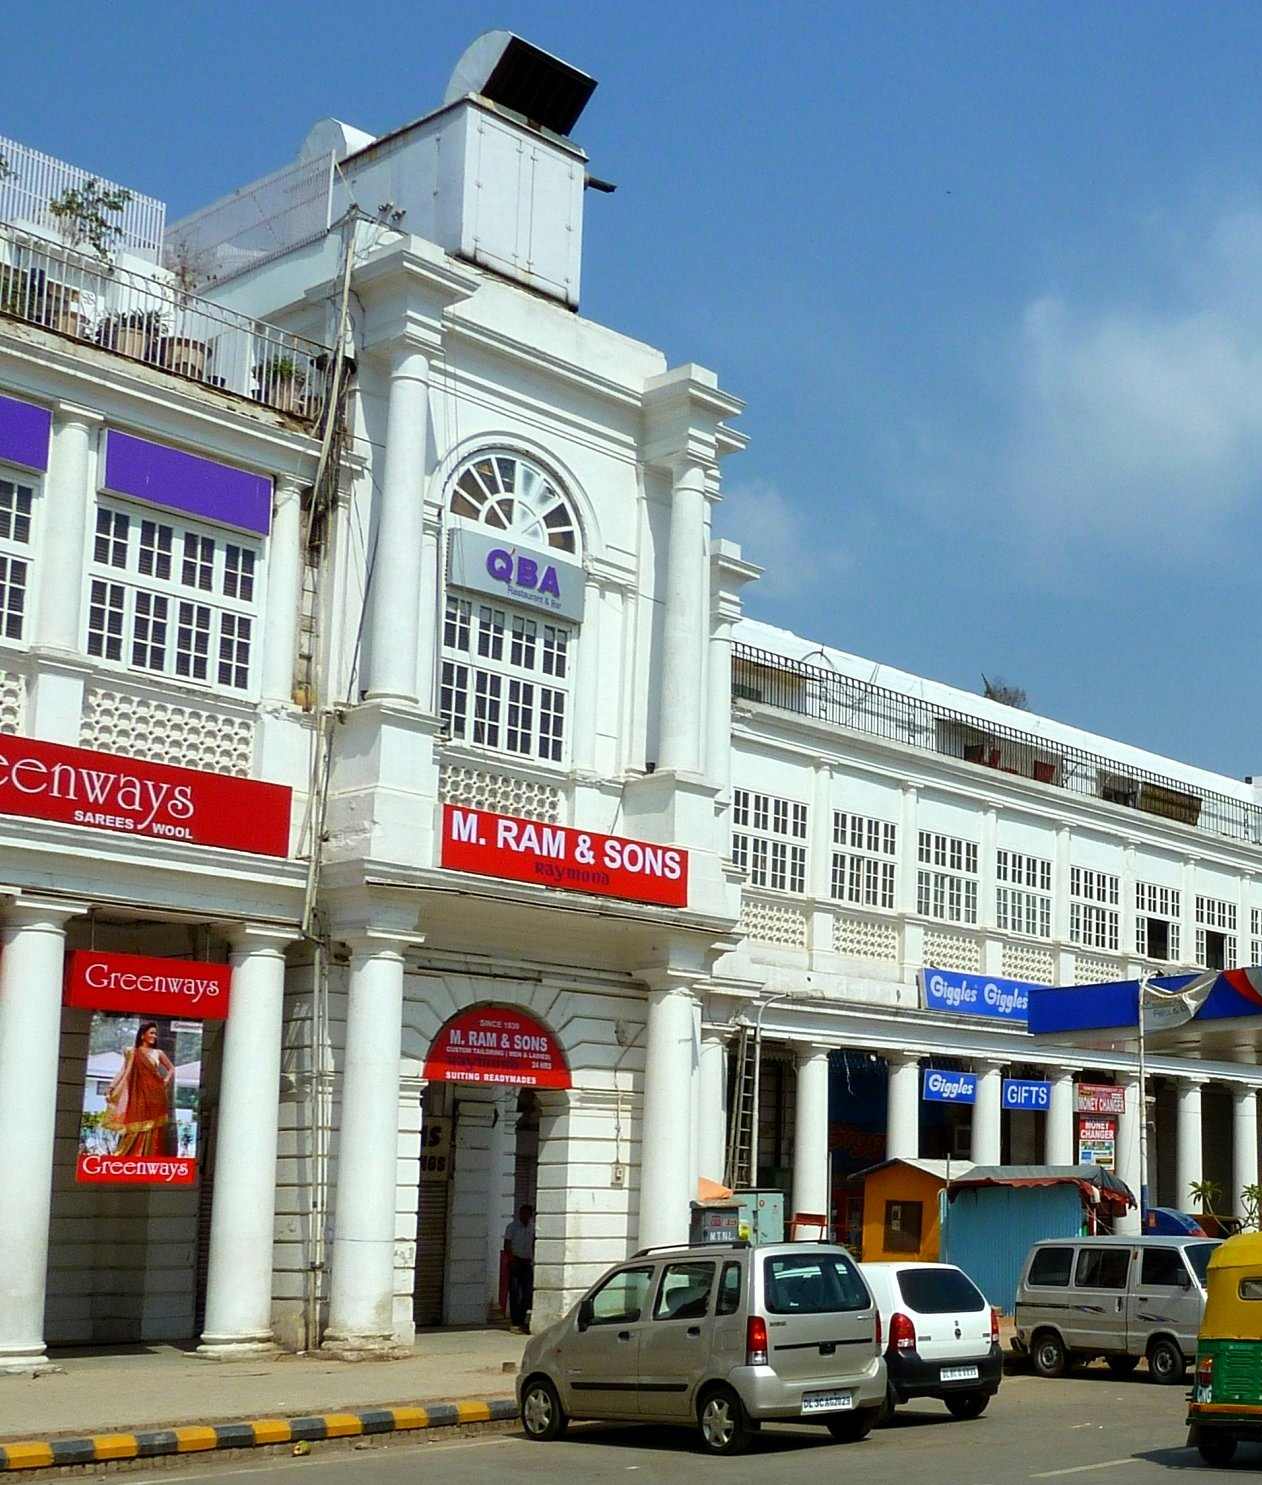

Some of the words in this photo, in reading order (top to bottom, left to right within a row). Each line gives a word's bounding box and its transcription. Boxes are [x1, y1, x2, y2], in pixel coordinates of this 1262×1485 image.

[73, 810, 135, 830] SAREES
[152, 822, 194, 839] WOOL
[452, 810, 486, 845] M.
[497, 818, 565, 859] RAM
[574, 834, 595, 864] &
[603, 839, 682, 880] SONS
[85, 963, 220, 1003] Greenways
[930, 974, 978, 1006] Giggles
[983, 982, 1028, 1014] Giggles
[480, 1019, 502, 1028] SINCE
[450, 1030, 465, 1045] M.
[469, 1031, 497, 1048] RAM
[501, 1033, 510, 1049] &
[514, 1034, 548, 1052] SONS
[473, 1048, 504, 1057] TAILORING
[445, 1071, 480, 1081] SUITING
[484, 1073, 537, 1085] READYMADES
[928, 1073, 975, 1098] Giggles
[1007, 1085, 1048, 1105] GIFTS
[1078, 1097, 1098, 1111] MONEY
[1099, 1098, 1125, 1113] CHANGER
[1080, 1129, 1114, 1139] CHANGER
[1085, 1120, 1109, 1130] MONEY
[82, 1155, 189, 1181] Greenways
